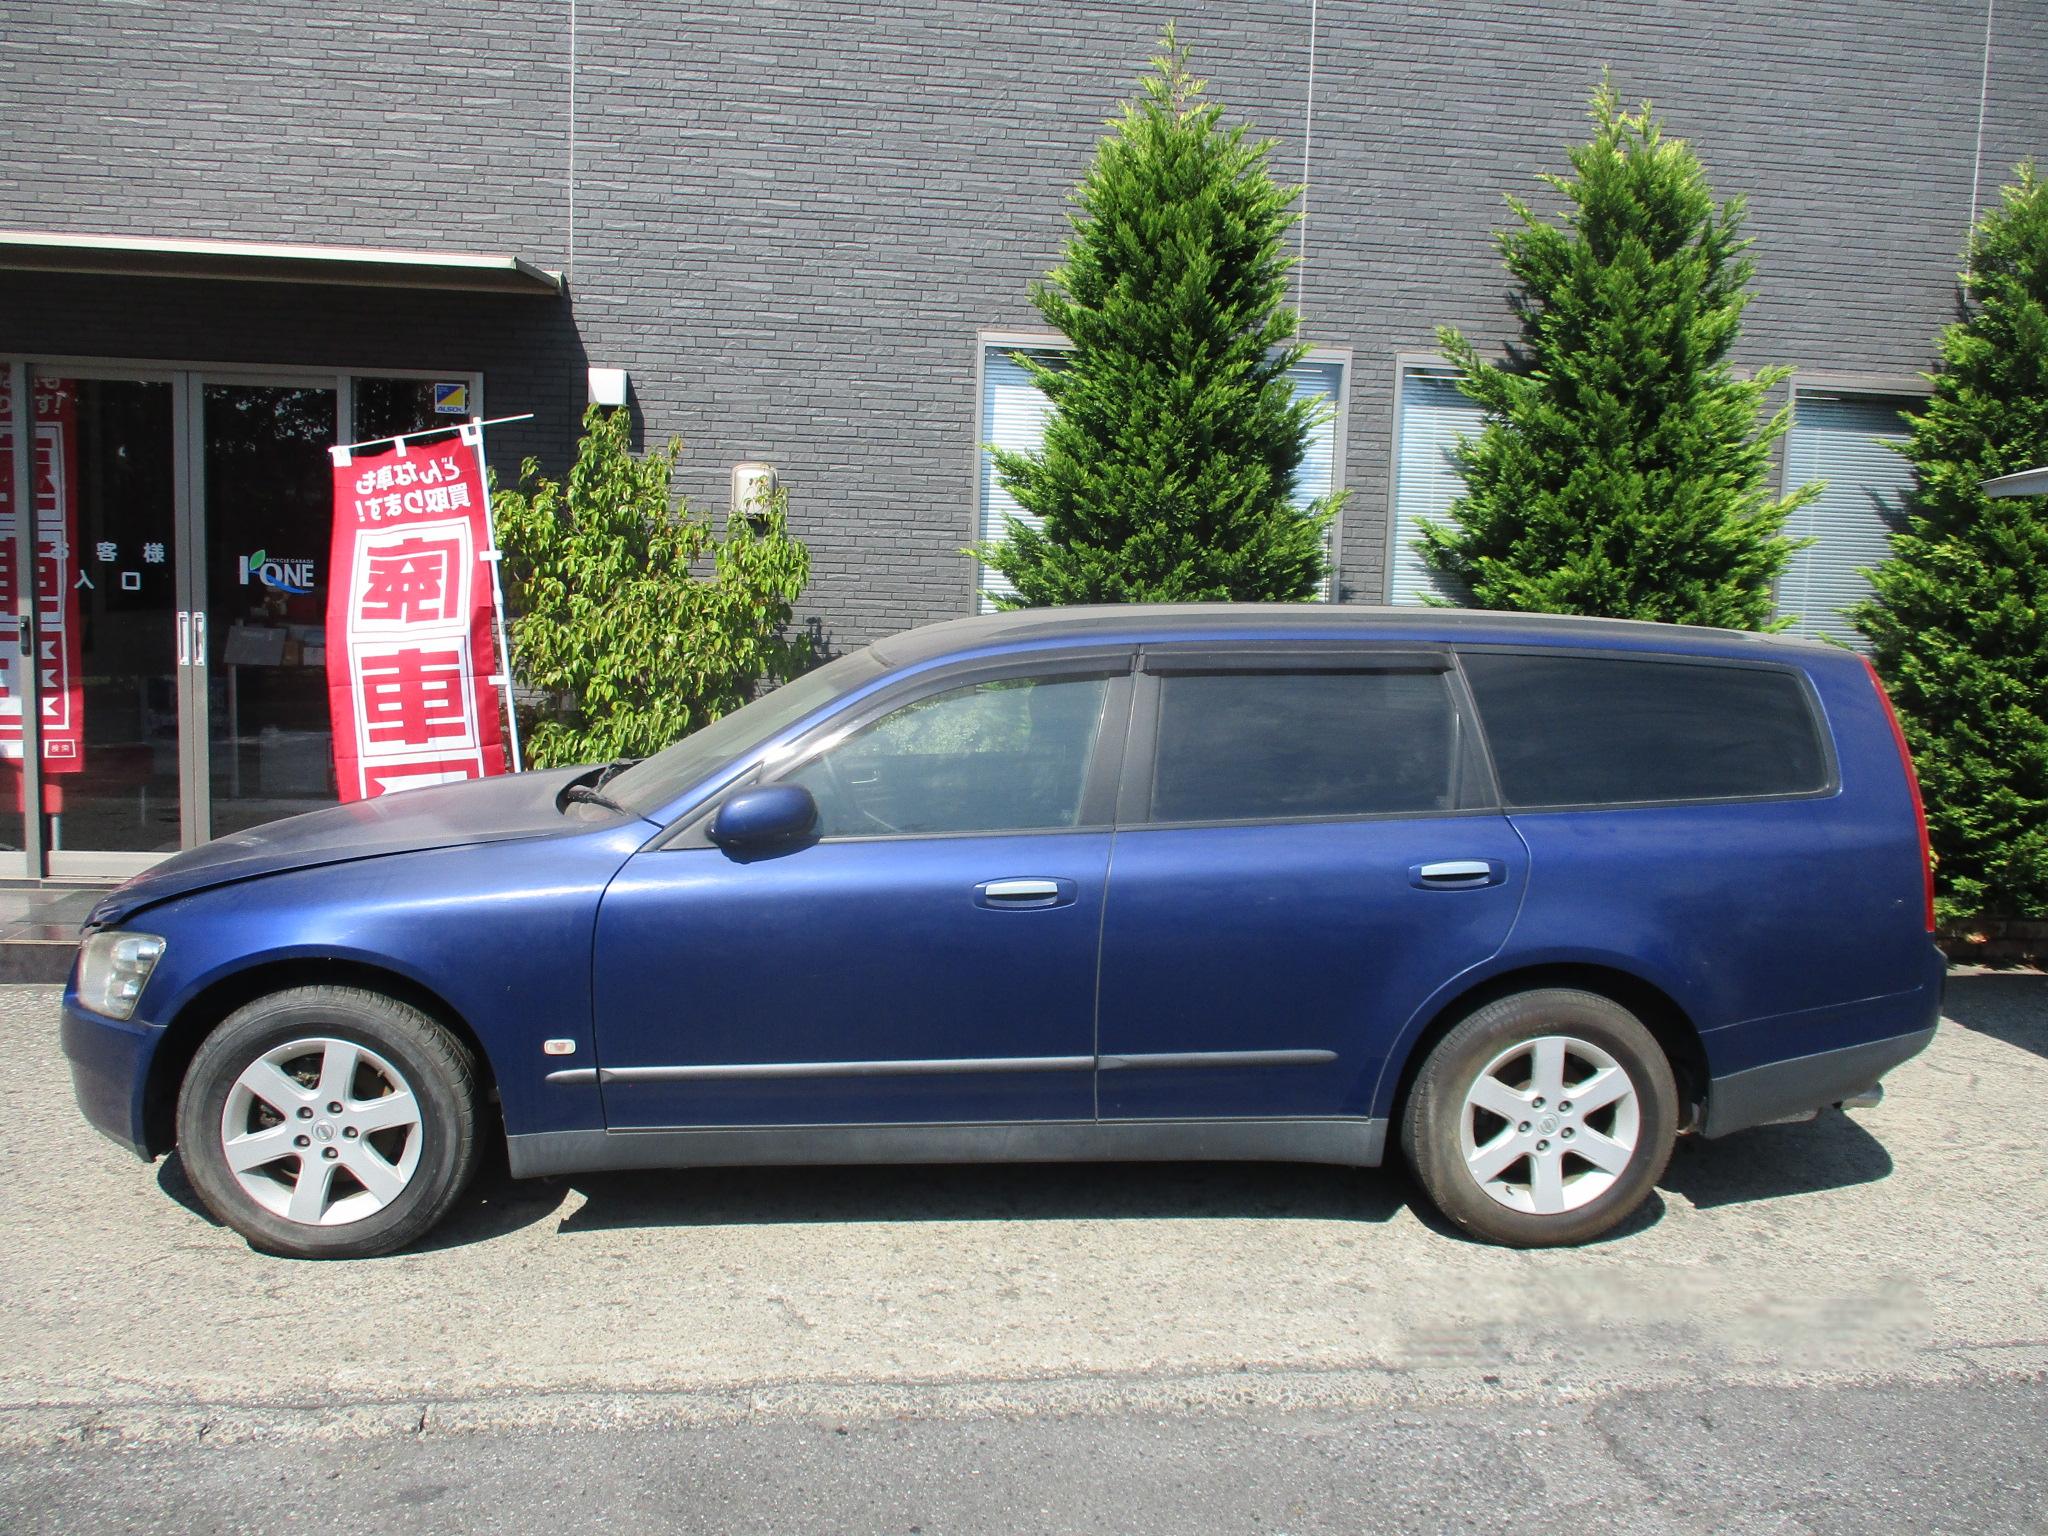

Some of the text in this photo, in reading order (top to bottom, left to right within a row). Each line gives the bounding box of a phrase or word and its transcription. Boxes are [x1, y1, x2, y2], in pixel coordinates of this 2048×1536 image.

[50, 541, 165, 563] お客様
[74, 569, 141, 591] 入口
